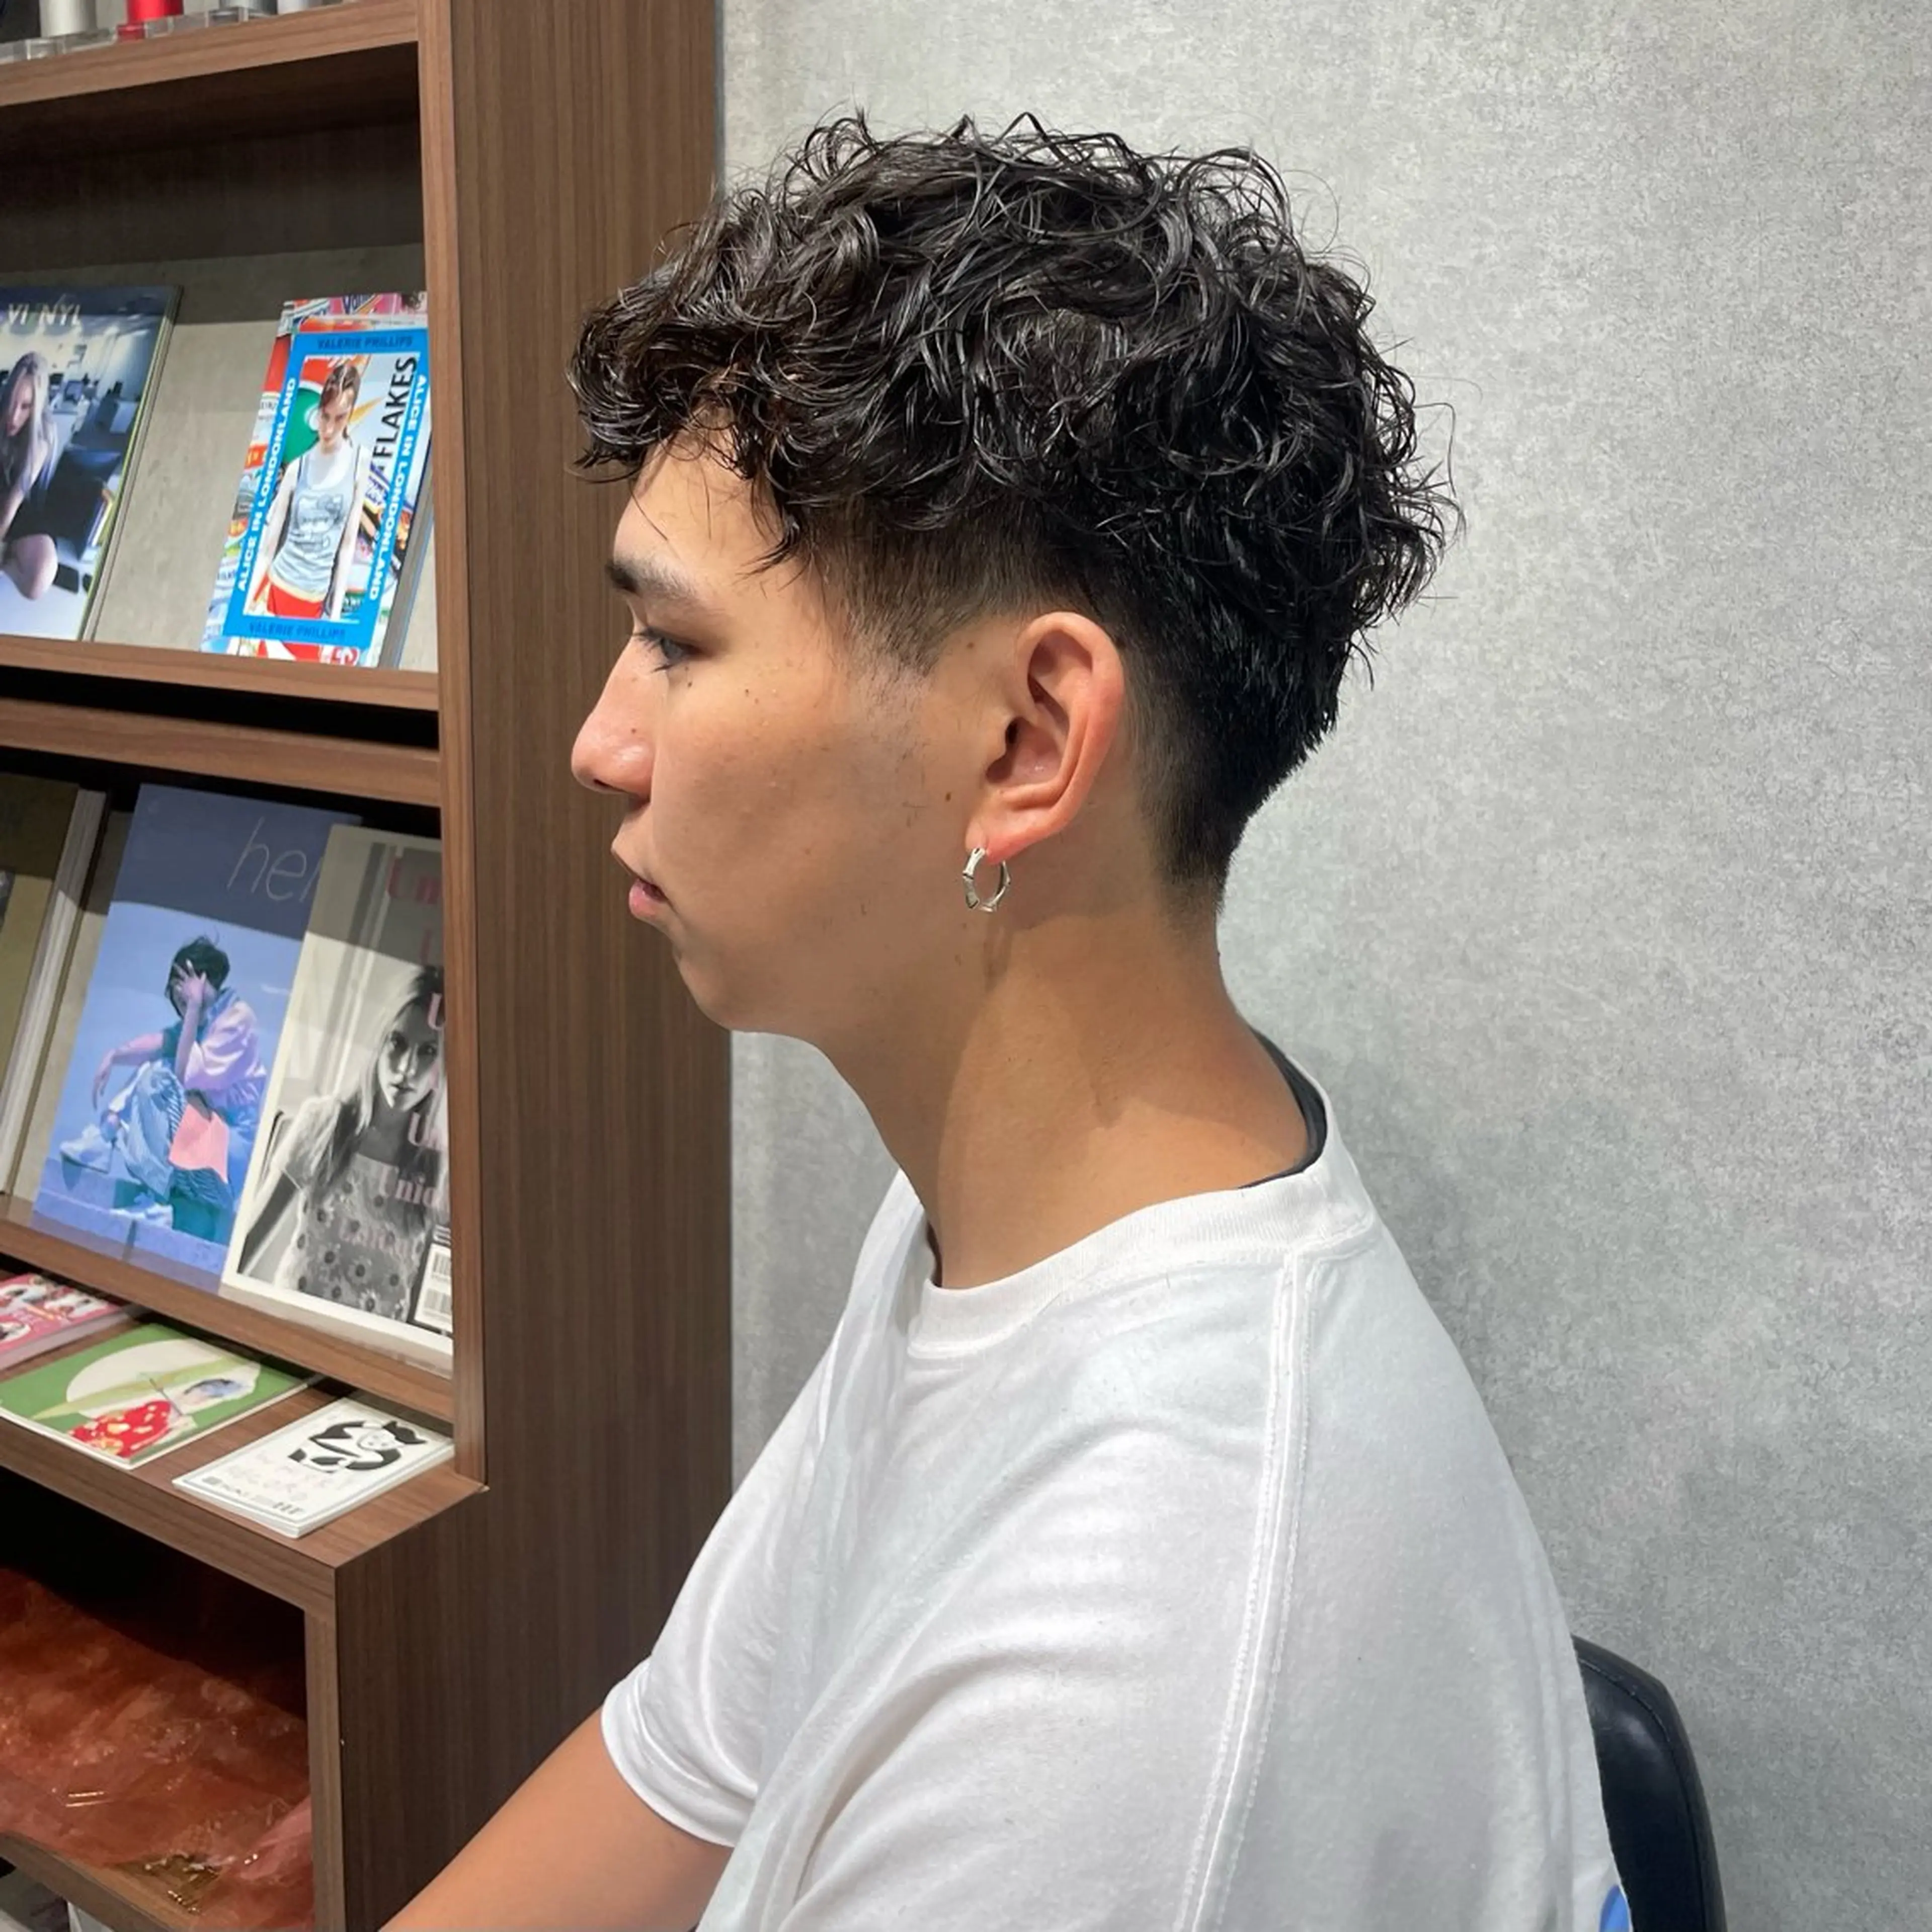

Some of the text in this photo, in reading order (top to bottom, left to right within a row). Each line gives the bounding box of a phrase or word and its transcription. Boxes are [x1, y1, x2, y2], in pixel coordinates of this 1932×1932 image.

[318, 335, 413, 349] VALERIE PHILLIPS
[408, 374, 427, 431] ALICE
[401, 436, 414, 456] IN
[237, 536, 257, 592] ALICE
[252, 511, 263, 531] IN
[258, 378, 296, 507] LONDONLAND
[369, 460, 409, 600] LONDONLAND
[249, 622, 346, 641] VALERIE PHILLIPS
